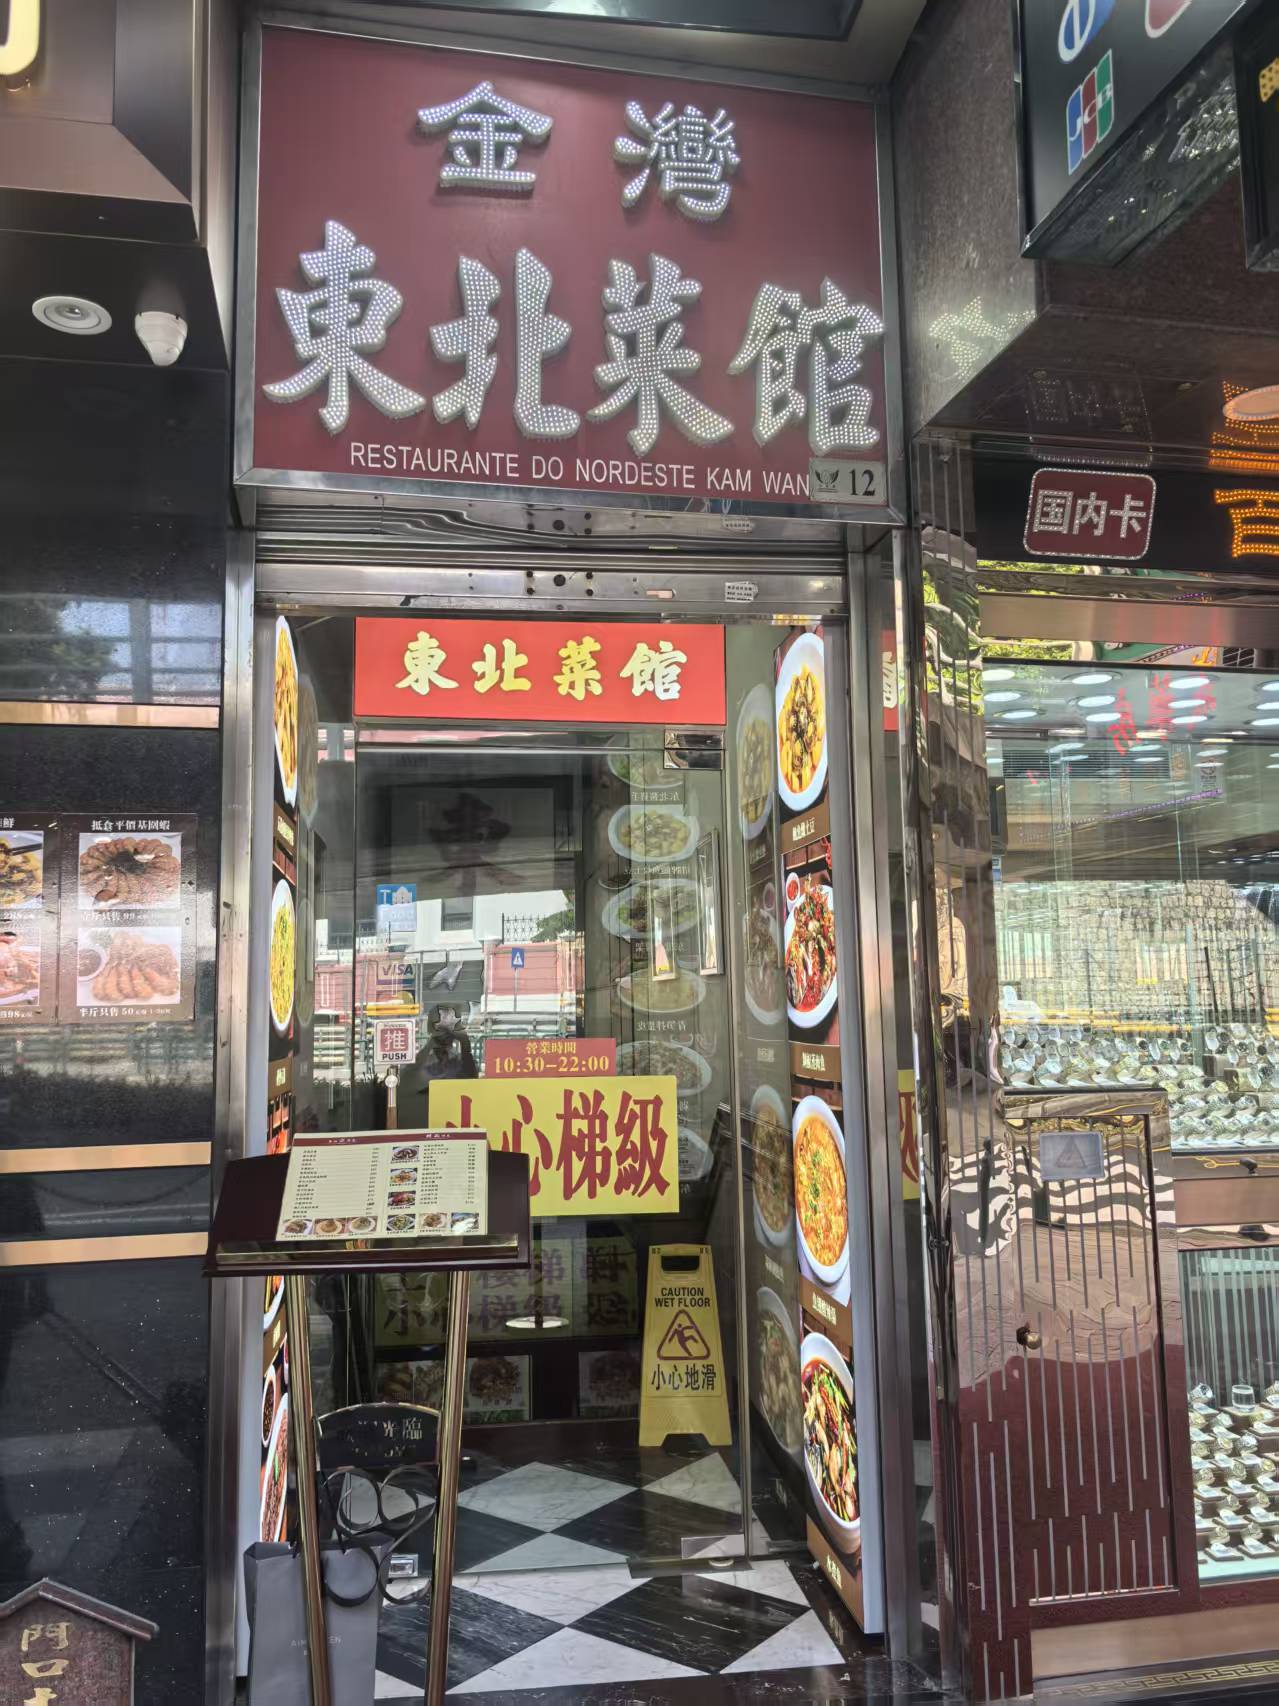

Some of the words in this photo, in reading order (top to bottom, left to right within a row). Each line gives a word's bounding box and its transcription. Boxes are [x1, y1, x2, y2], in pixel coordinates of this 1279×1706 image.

[1070, 83, 1113, 141] JCB
[418, 80, 741, 222] 金灣
[263, 219, 885, 456] 東北菜館
[350, 441, 520, 478] RESTAURANTE
[532, 455, 564, 480] DO
[576, 458, 696, 489] NORDESTE
[707, 467, 752, 492] KAM
[849, 469, 876, 497] 12
[1032, 490, 1147, 538] 国内卡
[395, 630, 687, 701] 東北菜館
[0, 818, 14, 828] 鮮
[383, 963, 415, 976] VISA
[384, 1030, 405, 1051] 推
[381, 1052, 407, 1061] PUSH
[655, 1297, 676, 1308] WET
[678, 1297, 711, 1308] FLOOR
[661, 1287, 704, 1298] CAUTION
[651, 1363, 717, 1391] 小心地滑
